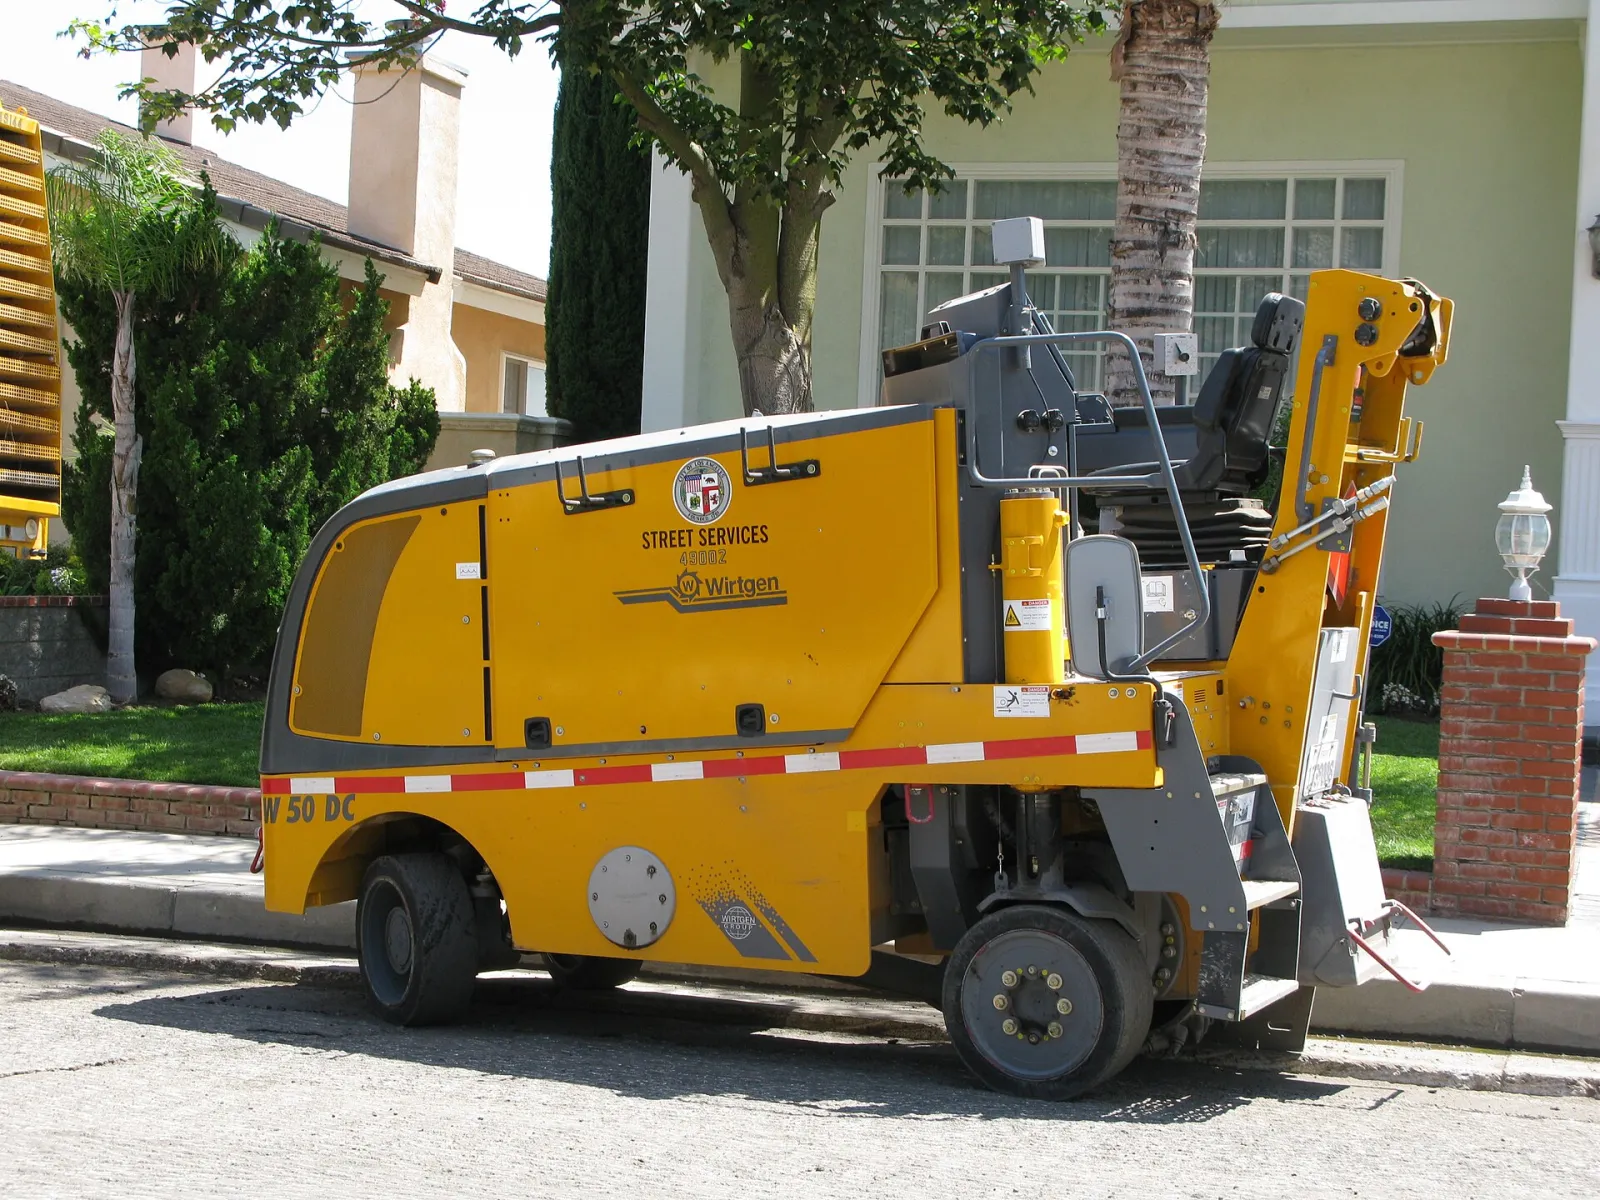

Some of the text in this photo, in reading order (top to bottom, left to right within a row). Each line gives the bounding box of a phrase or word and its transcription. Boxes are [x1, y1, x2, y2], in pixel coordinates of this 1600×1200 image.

[642, 525, 769, 550] STREET SERVICES
[680, 549, 727, 566] 49002
[705, 576, 779, 597] Wirtgen
[263, 793, 356, 824] W 50 DC
[721, 914, 756, 924] WIRTGEN
